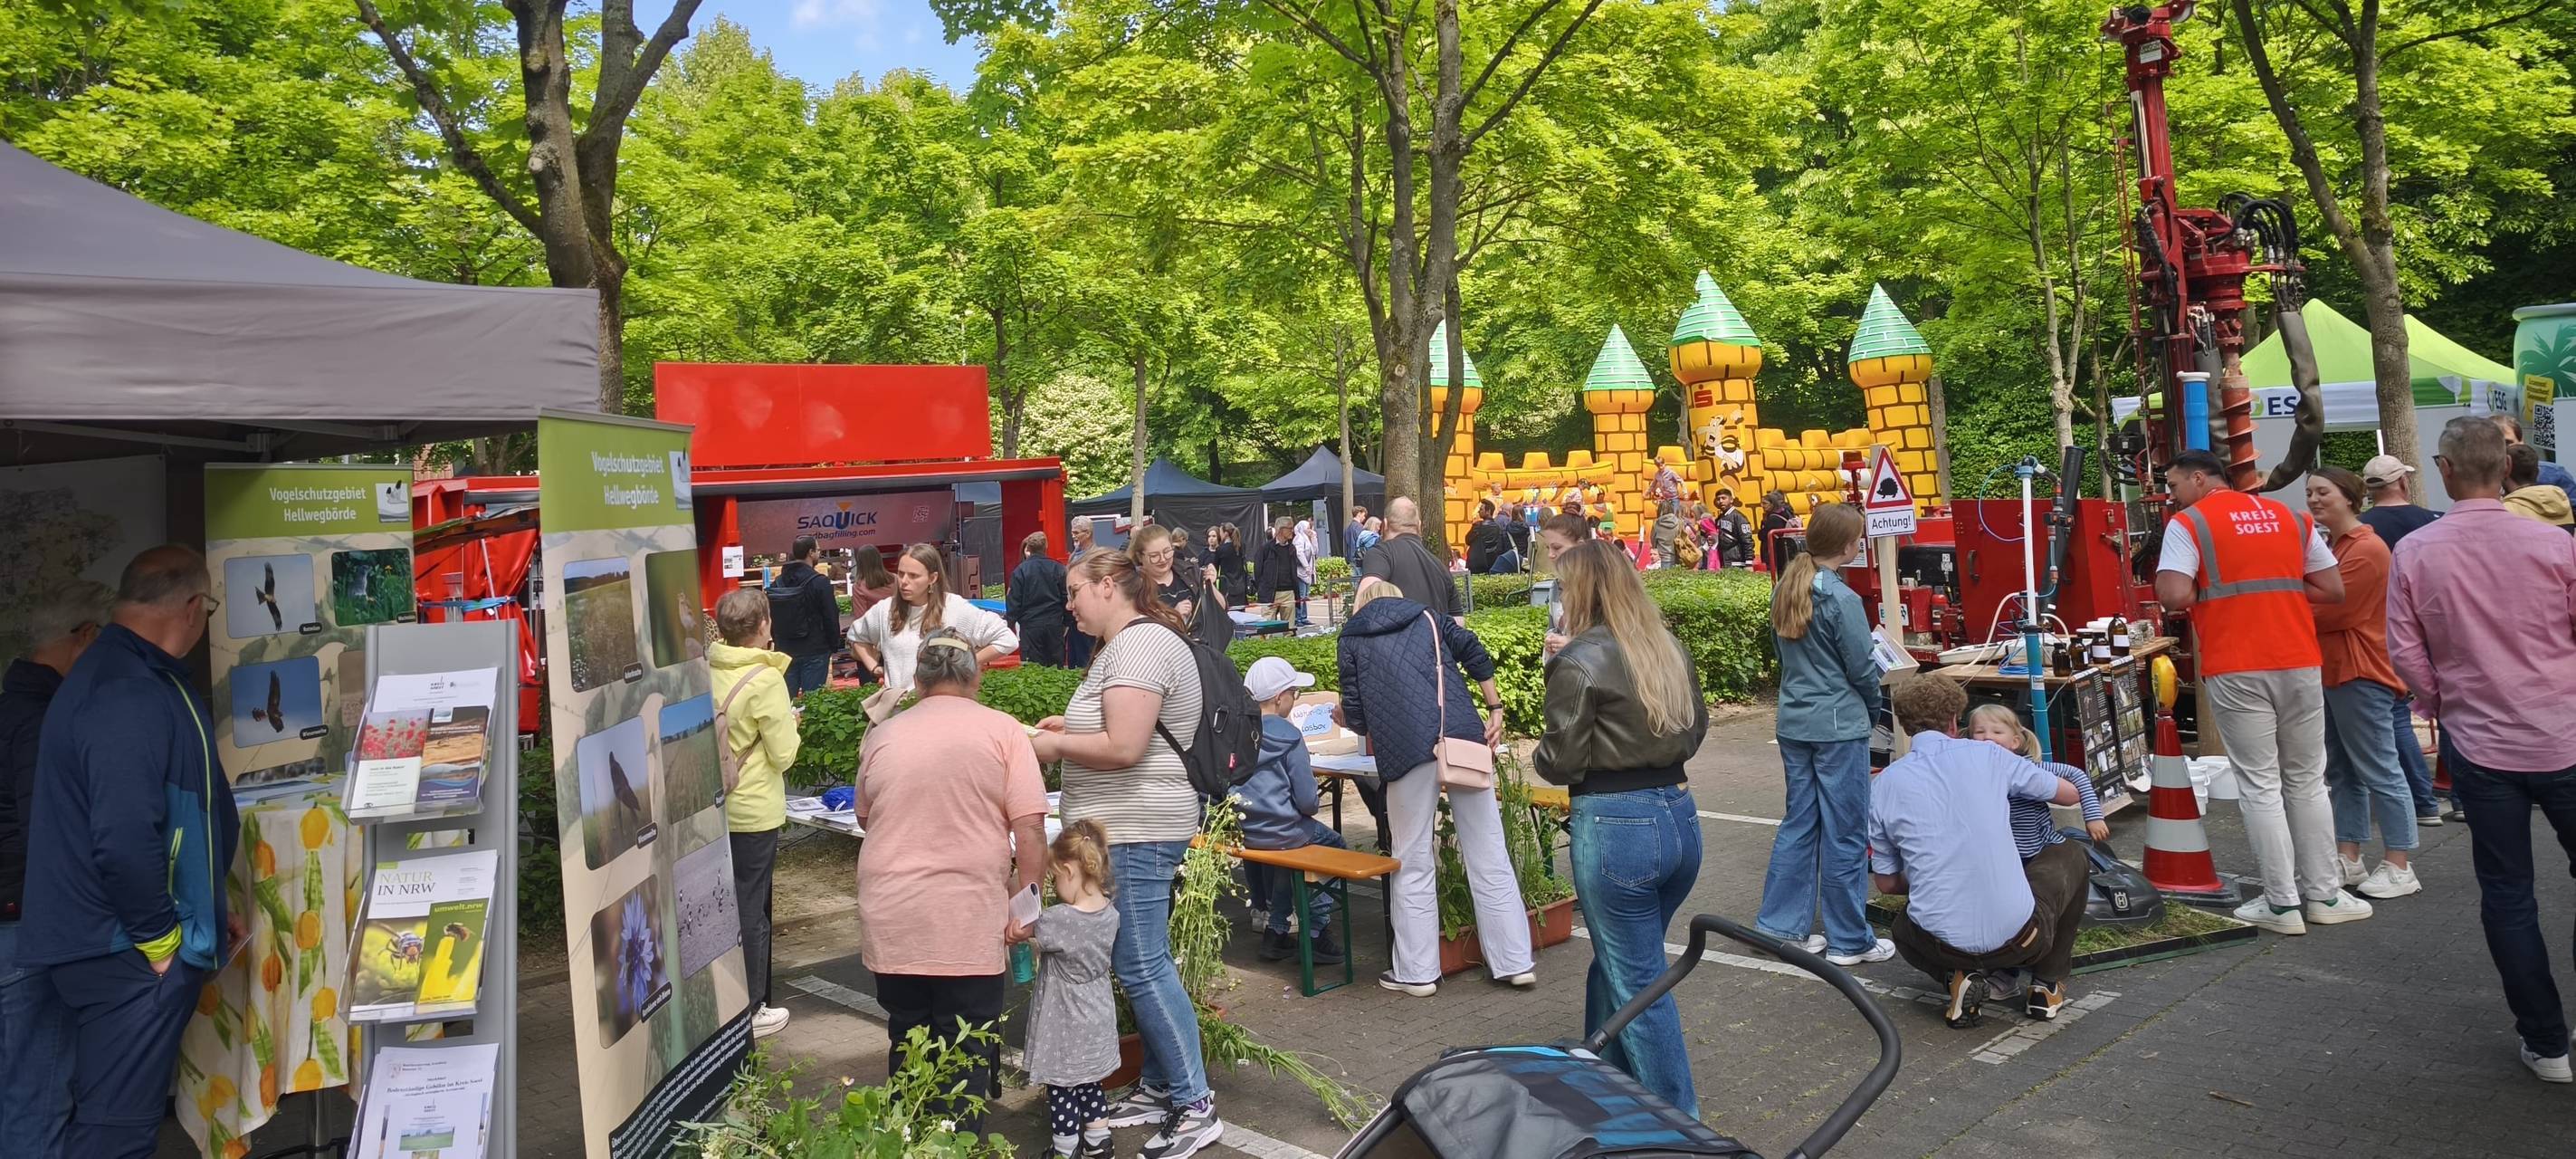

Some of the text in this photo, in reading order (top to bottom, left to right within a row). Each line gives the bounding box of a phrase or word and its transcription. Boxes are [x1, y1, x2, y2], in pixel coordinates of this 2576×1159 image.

[2267, 396, 2297, 416] ES
[2495, 390, 2507, 411] ESG
[591, 451, 664, 477] Vogelschutzgebiet
[269, 487, 367, 503] Vogelschutzgebiet
[604, 484, 660, 509] Hellwegbörde
[283, 508, 357, 523] Hellwegbörde
[797, 511, 878, 530] SAQUICK
[1872, 515, 1912, 530] Achtung!
[2229, 509, 2276, 522] KREIS
[2236, 522, 2280, 535] SOEST
[380, 870, 433, 884] NATUR
[377, 882, 436, 896] IN NRW
[434, 902, 483, 913] umwelt.nrw
